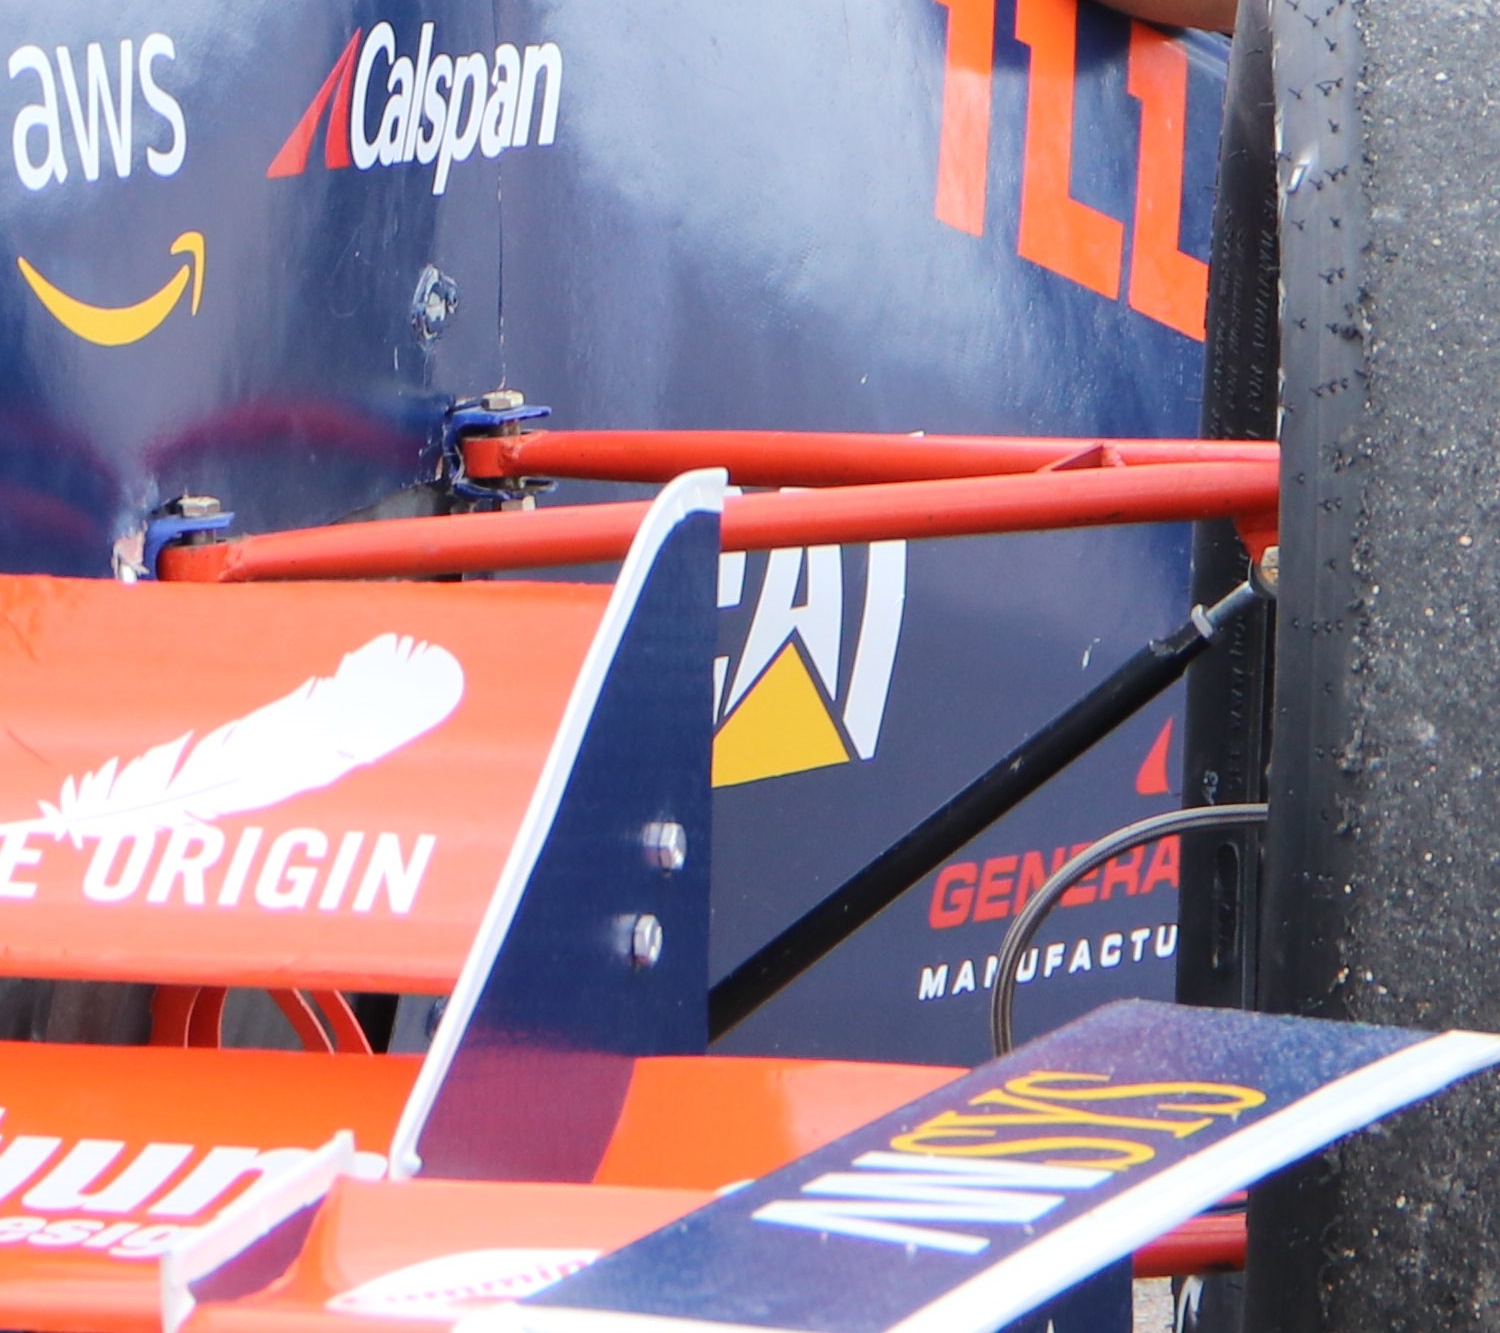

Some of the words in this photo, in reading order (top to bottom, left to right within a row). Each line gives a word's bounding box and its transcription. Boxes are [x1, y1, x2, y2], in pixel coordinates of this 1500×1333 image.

[6, 30, 188, 192] aws
[348, 19, 563, 196] Calspan
[78, 821, 438, 915] ORIGIN
[927, 833, 1182, 930] GENERA
